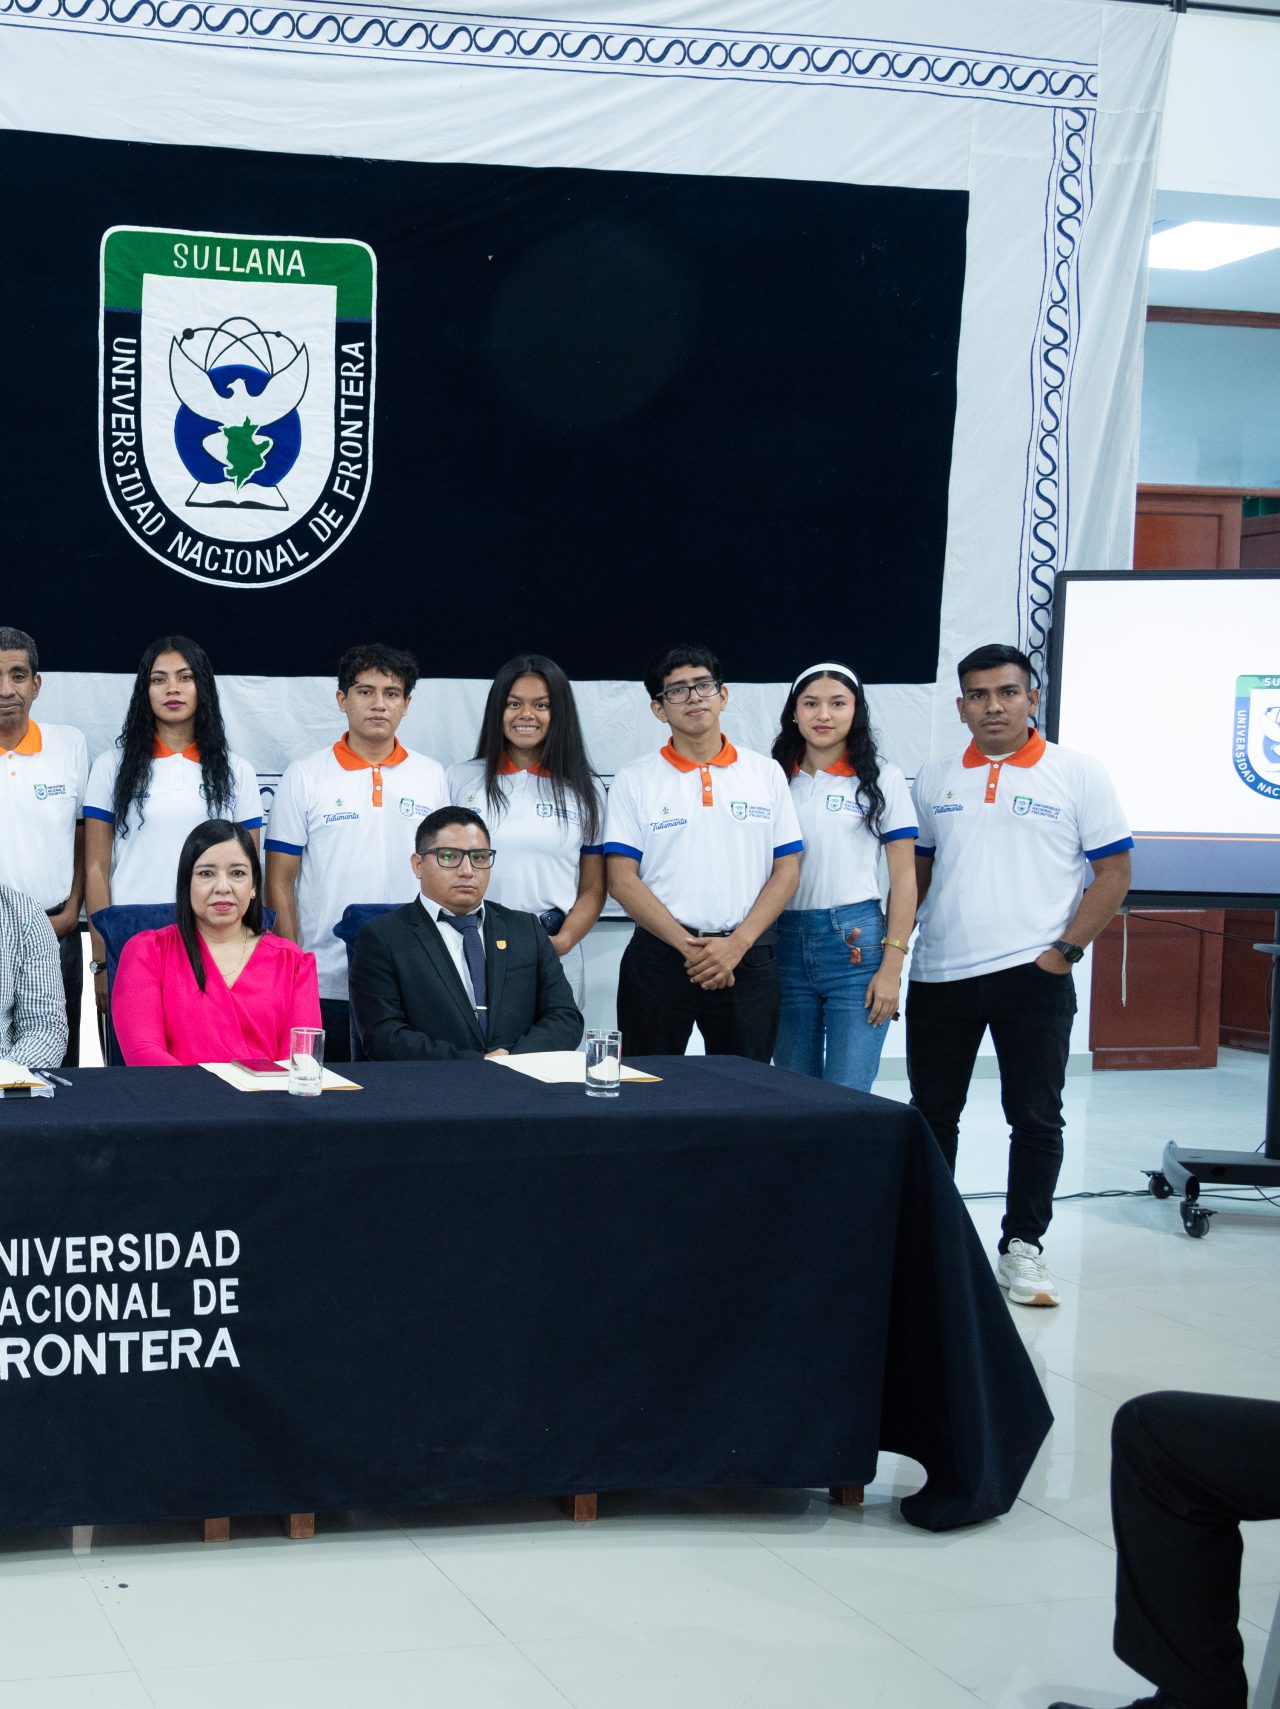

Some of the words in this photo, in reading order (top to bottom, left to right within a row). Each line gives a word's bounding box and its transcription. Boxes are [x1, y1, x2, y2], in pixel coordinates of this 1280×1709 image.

[173, 243, 306, 277] SULLANA
[111, 337, 166, 536] UNIVERSIDAD
[167, 531, 309, 576] NACIONAL
[309, 502, 344, 543] DE
[332, 341, 365, 501] FRONTERA
[1235, 710, 1256, 783] UNIVERSIDAD
[193, 1278, 239, 1316] DE
